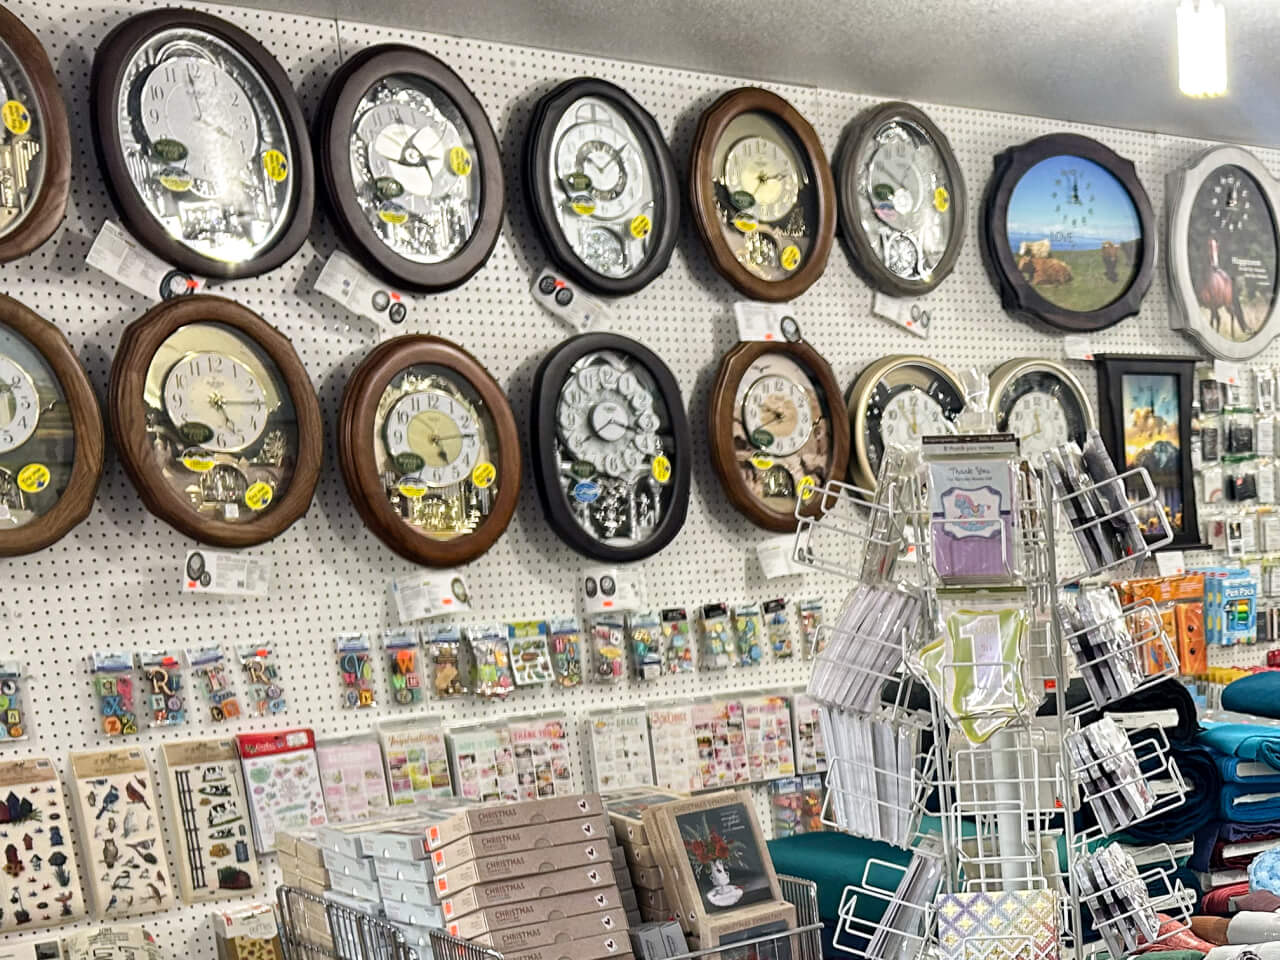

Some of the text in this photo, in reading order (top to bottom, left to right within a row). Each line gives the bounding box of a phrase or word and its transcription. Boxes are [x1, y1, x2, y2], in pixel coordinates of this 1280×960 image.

[208, 356, 222, 372] 12
[428, 393, 439, 409] 12
[948, 467, 991, 476] Thank You
[478, 808, 517, 819] CHRISTMAS
[482, 833, 521, 844] CHRISTMAS
[486, 858, 525, 869] CHRISTMAS
[485, 883, 525, 894] CHRISTMAS
[495, 906, 534, 918] CHRISTMAS
[502, 928, 541, 942] CHRISTMAS
